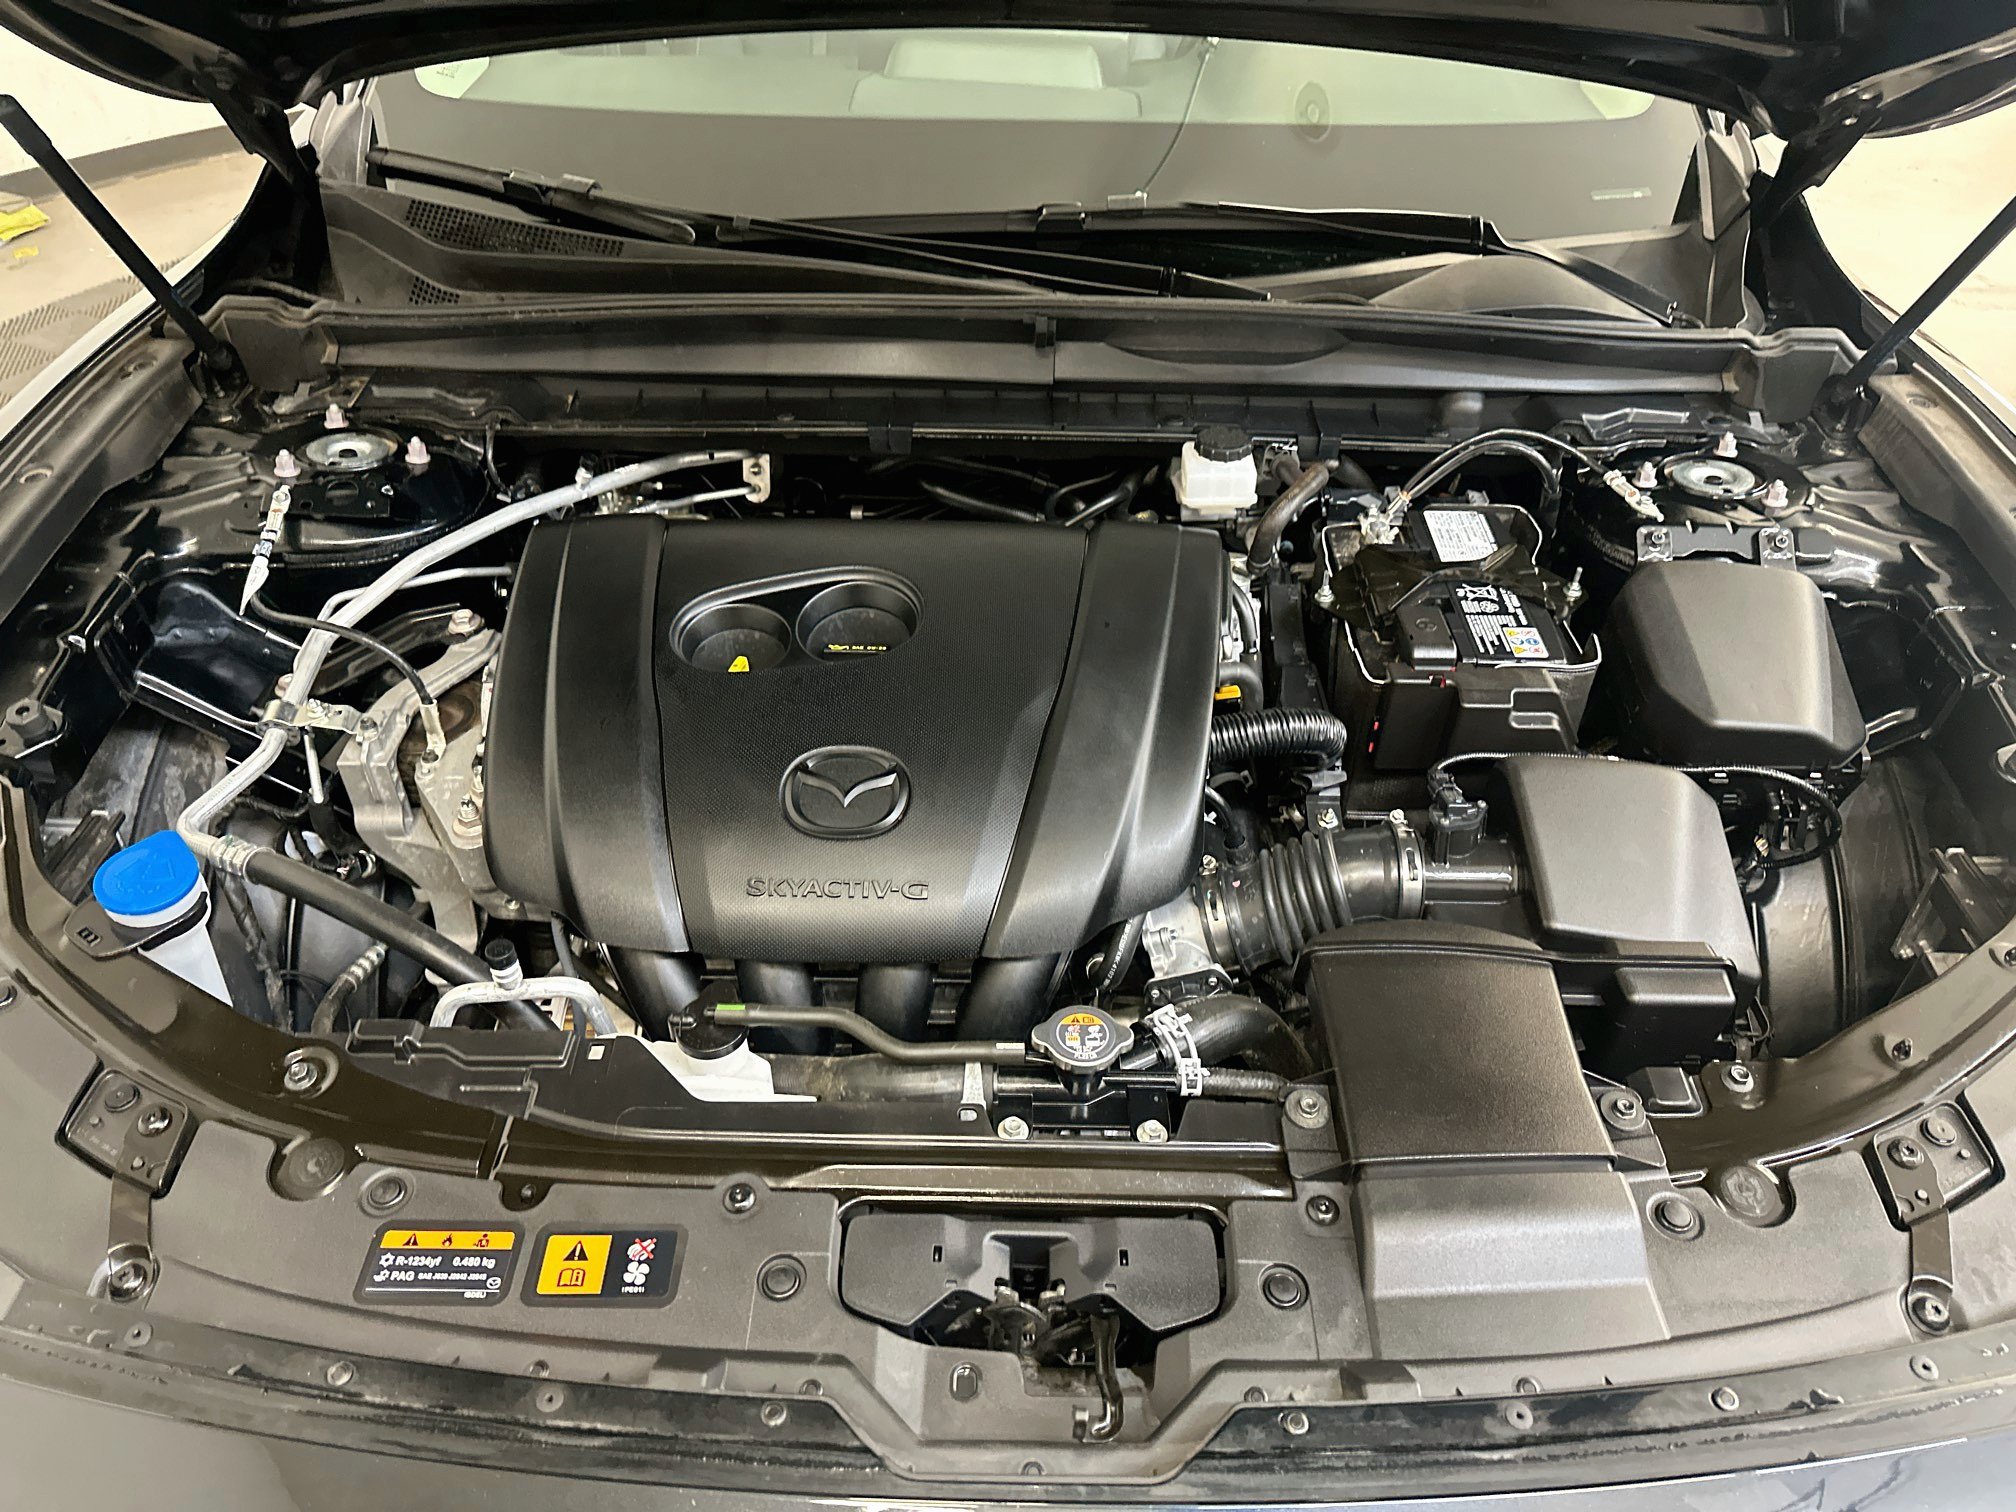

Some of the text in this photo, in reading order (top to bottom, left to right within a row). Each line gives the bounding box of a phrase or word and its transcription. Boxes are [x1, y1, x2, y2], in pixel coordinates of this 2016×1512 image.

[746, 878, 929, 900] SKYACTIV-G
[395, 1256, 442, 1268] R-1234yf
[481, 1257, 496, 1269] kg
[390, 1271, 415, 1281] PAG
